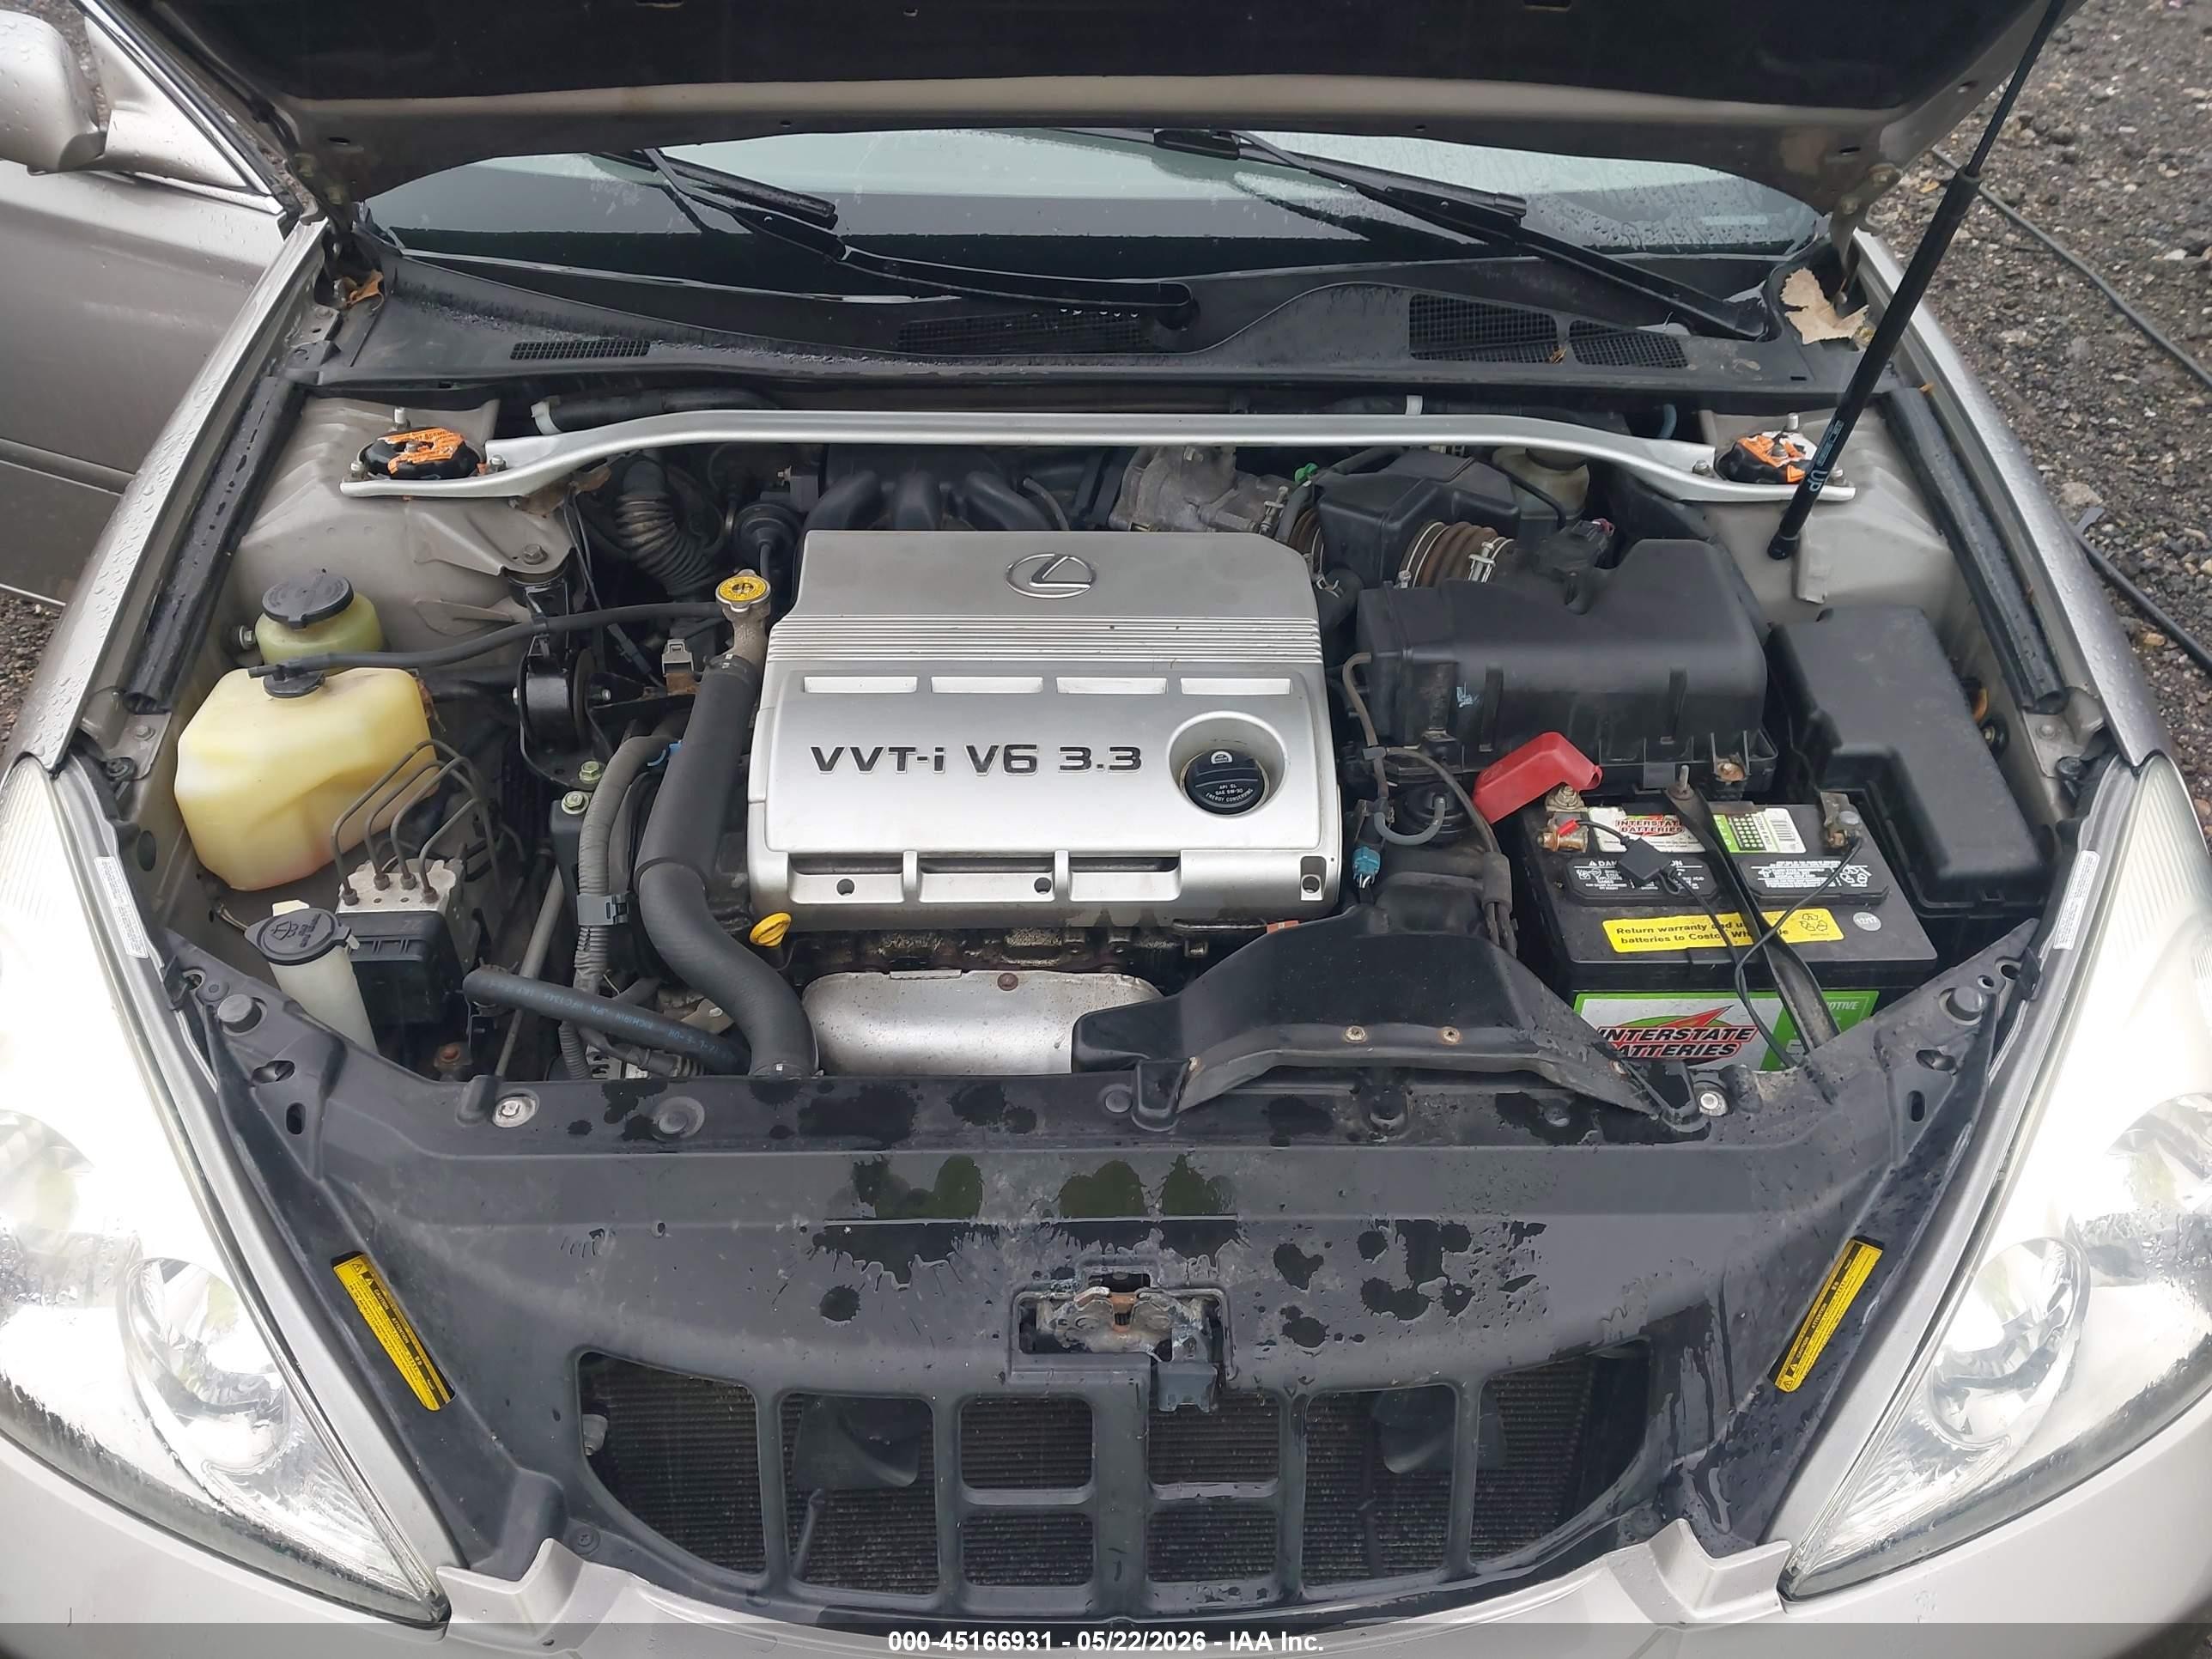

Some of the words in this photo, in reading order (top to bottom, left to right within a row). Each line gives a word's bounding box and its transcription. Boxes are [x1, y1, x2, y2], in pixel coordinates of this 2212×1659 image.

[1807, 470, 1828, 492] UP
[810, 745, 946, 775] VVT-i
[964, 744, 1038, 776] V6
[1058, 745, 1143, 774] 3.3
[1657, 922, 1708, 933] warranty
[1621, 935, 1671, 944] batteries
[1599, 1027, 1754, 1042] INTERSTATE
[1620, 1042, 1737, 1056] ATTERIES
